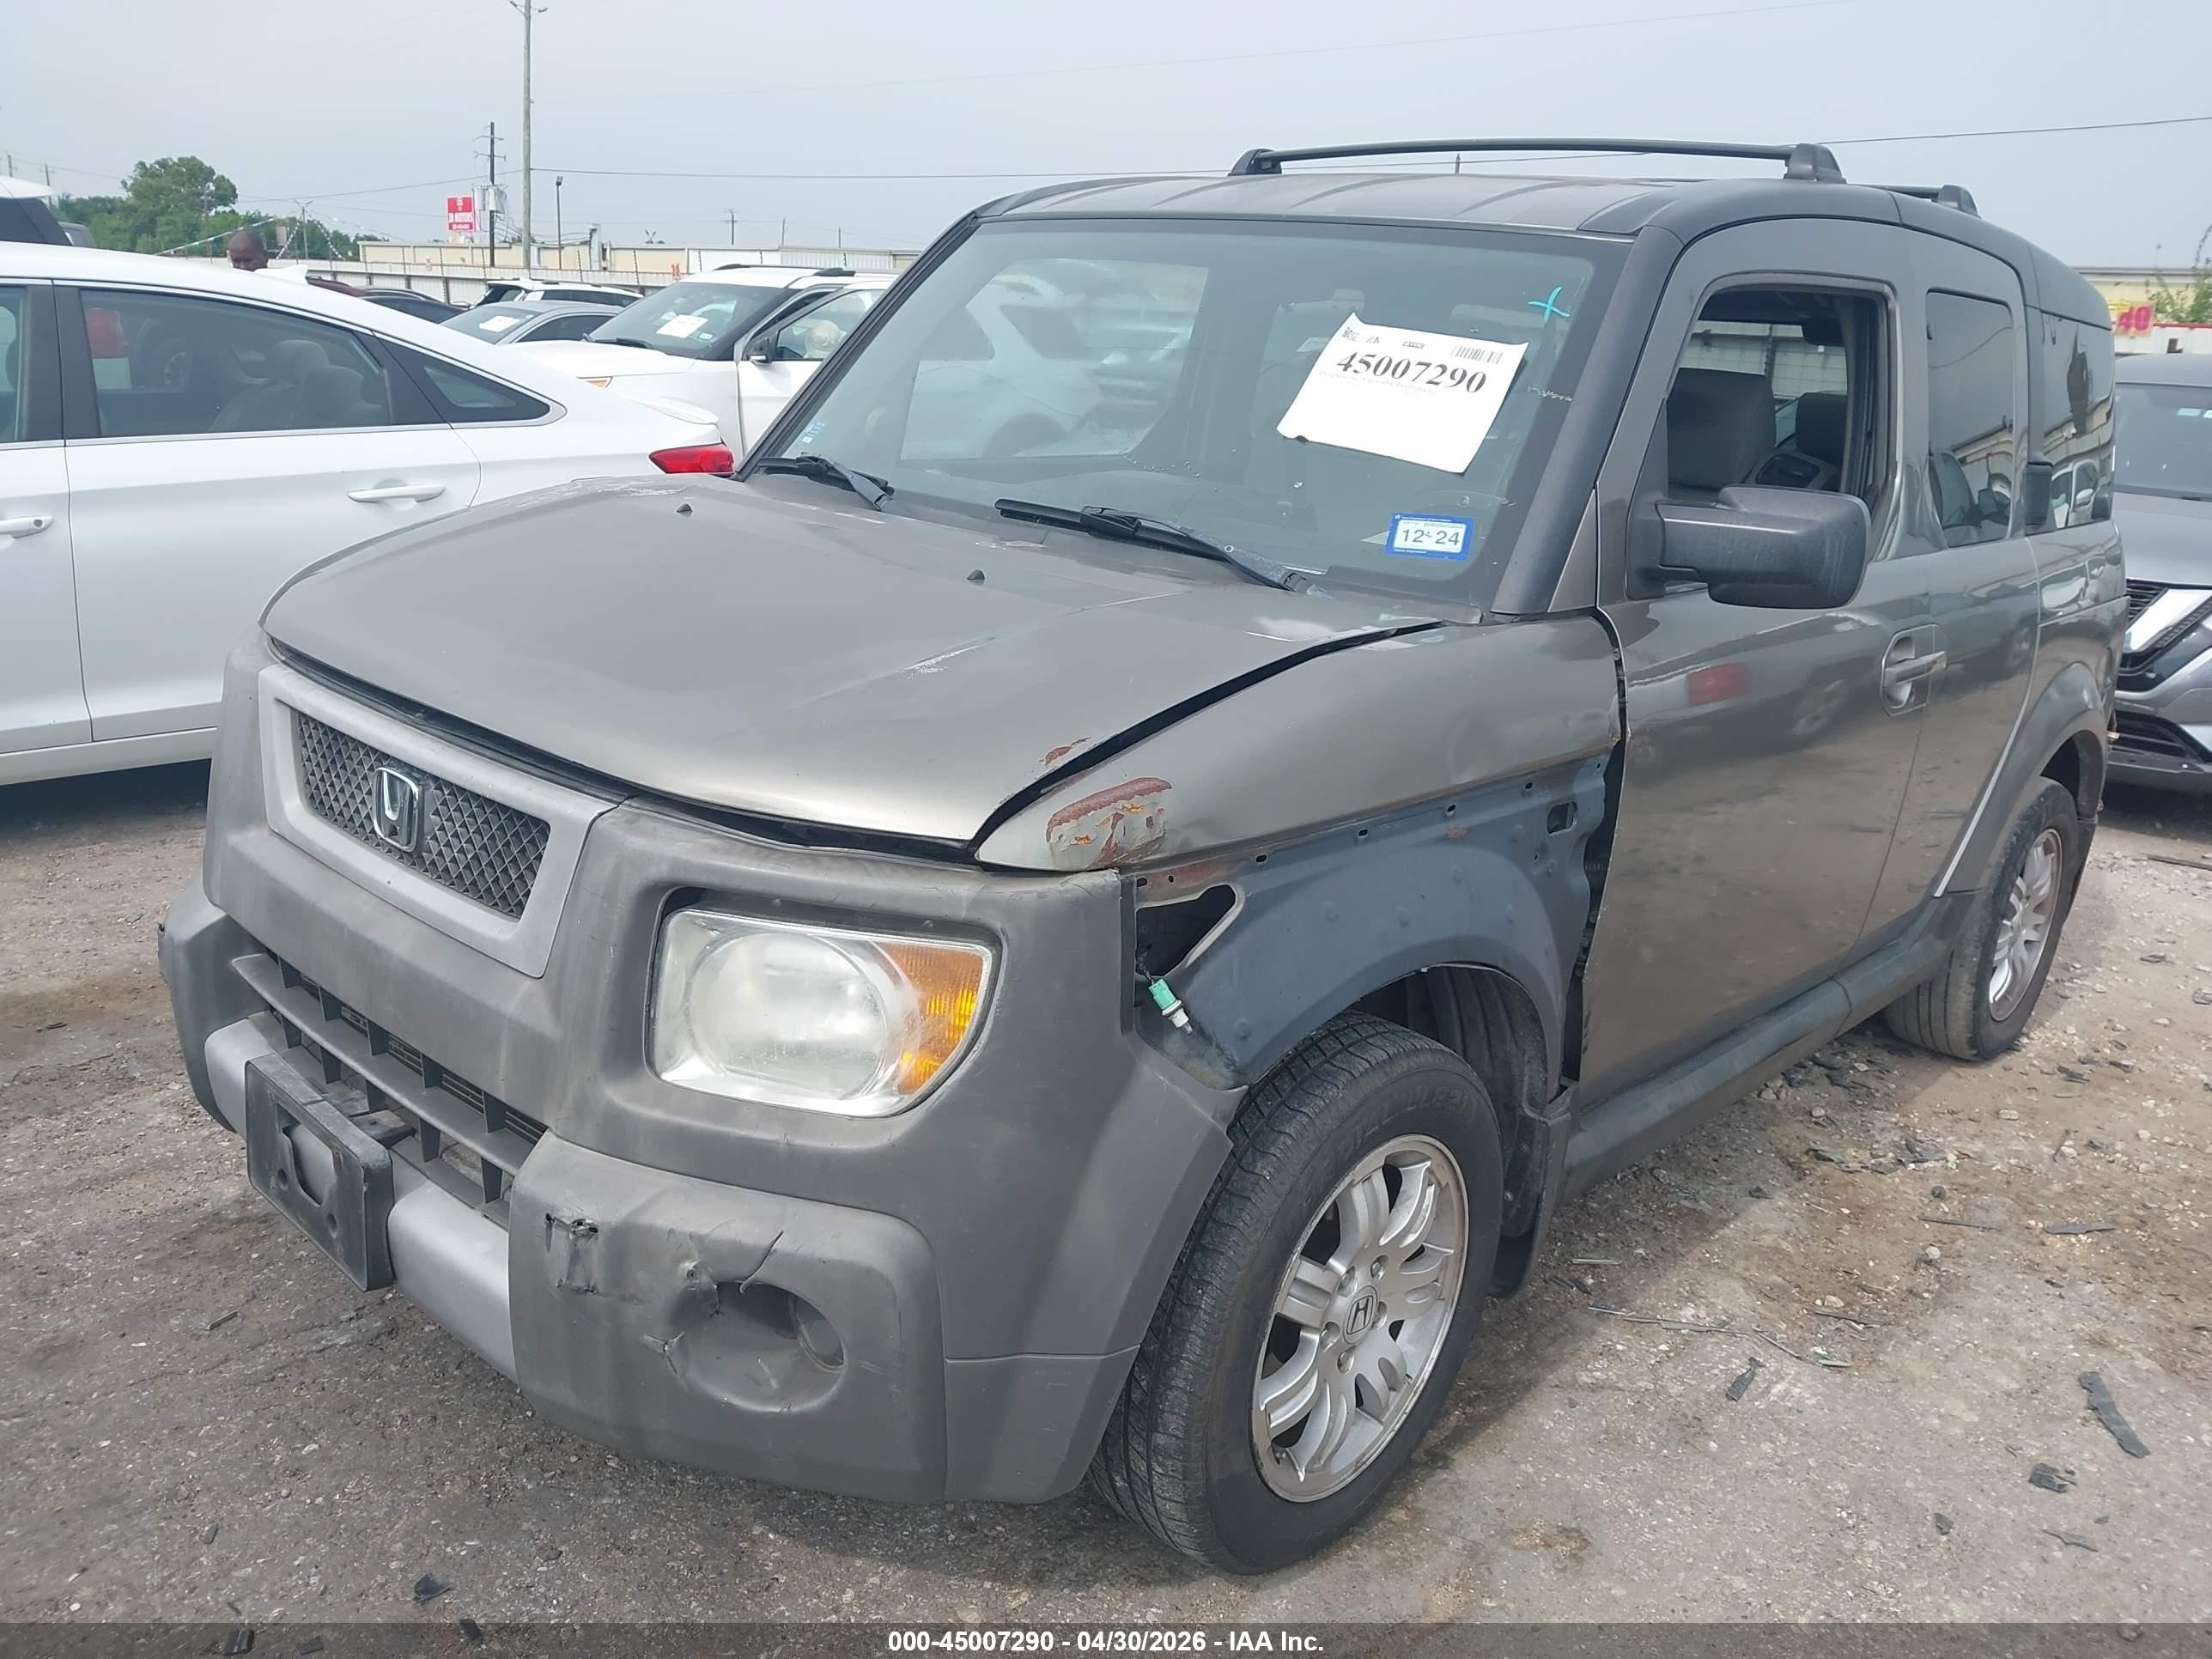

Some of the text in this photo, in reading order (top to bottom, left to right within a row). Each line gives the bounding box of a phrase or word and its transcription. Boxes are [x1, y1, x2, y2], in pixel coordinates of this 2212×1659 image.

[1336, 351, 1487, 393] 45007290
[1401, 528, 1460, 546] 12 24
